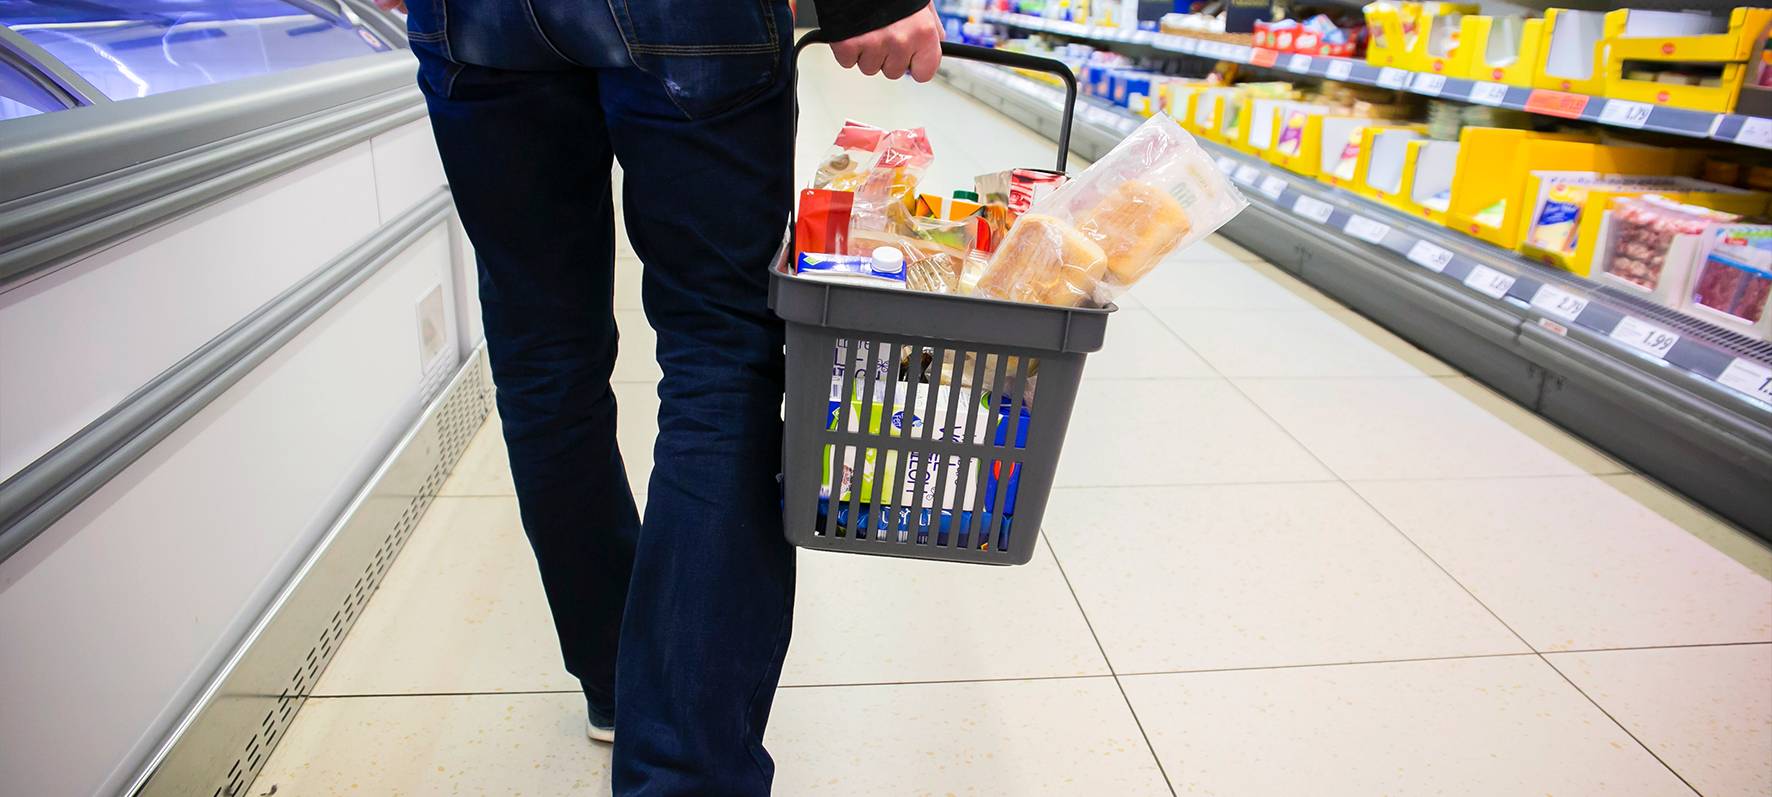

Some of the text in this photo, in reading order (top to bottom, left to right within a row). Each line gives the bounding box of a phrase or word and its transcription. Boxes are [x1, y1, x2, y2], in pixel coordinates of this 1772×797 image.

[1557, 296, 1584, 314] 2.79
[1643, 330, 1674, 350] 1.99
[1758, 377, 1772, 396] 1.
